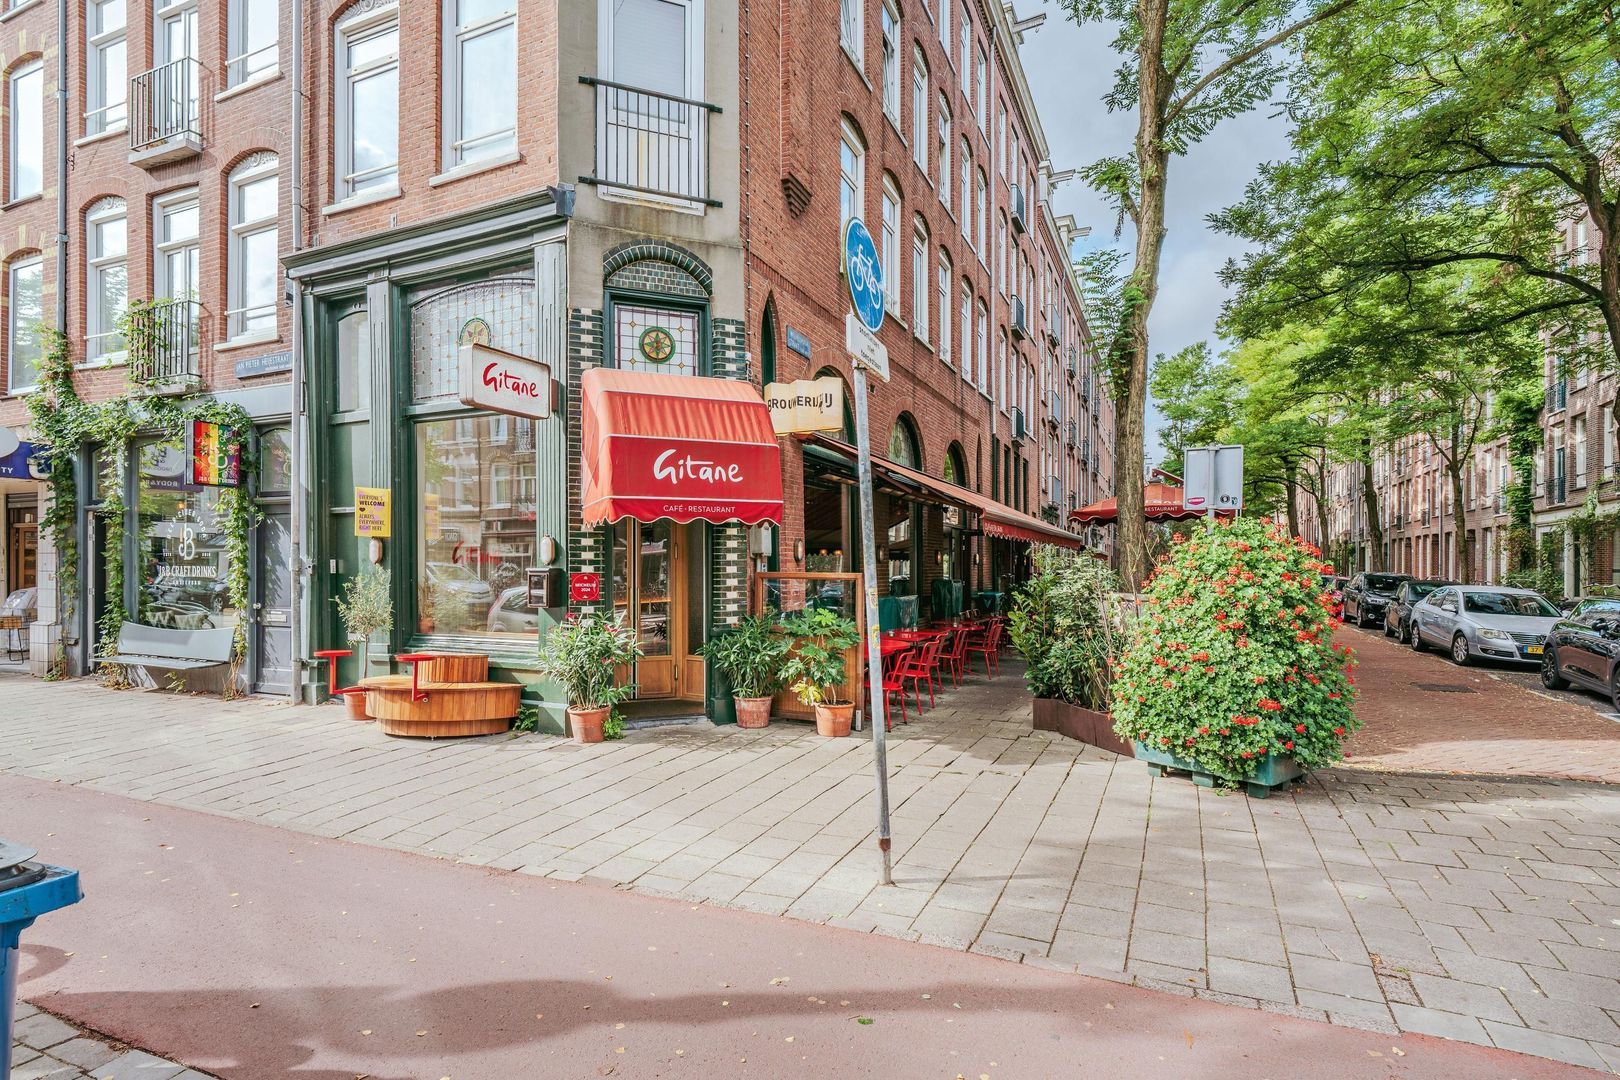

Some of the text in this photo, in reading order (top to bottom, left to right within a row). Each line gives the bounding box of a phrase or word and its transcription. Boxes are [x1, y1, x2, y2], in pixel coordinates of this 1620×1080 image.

[483, 362, 539, 398] Gitane
[653, 448, 744, 485] Gitane
[663, 504, 683, 513] CAFÉ
[159, 565, 217, 577] J&B CRAFT DRINKS
